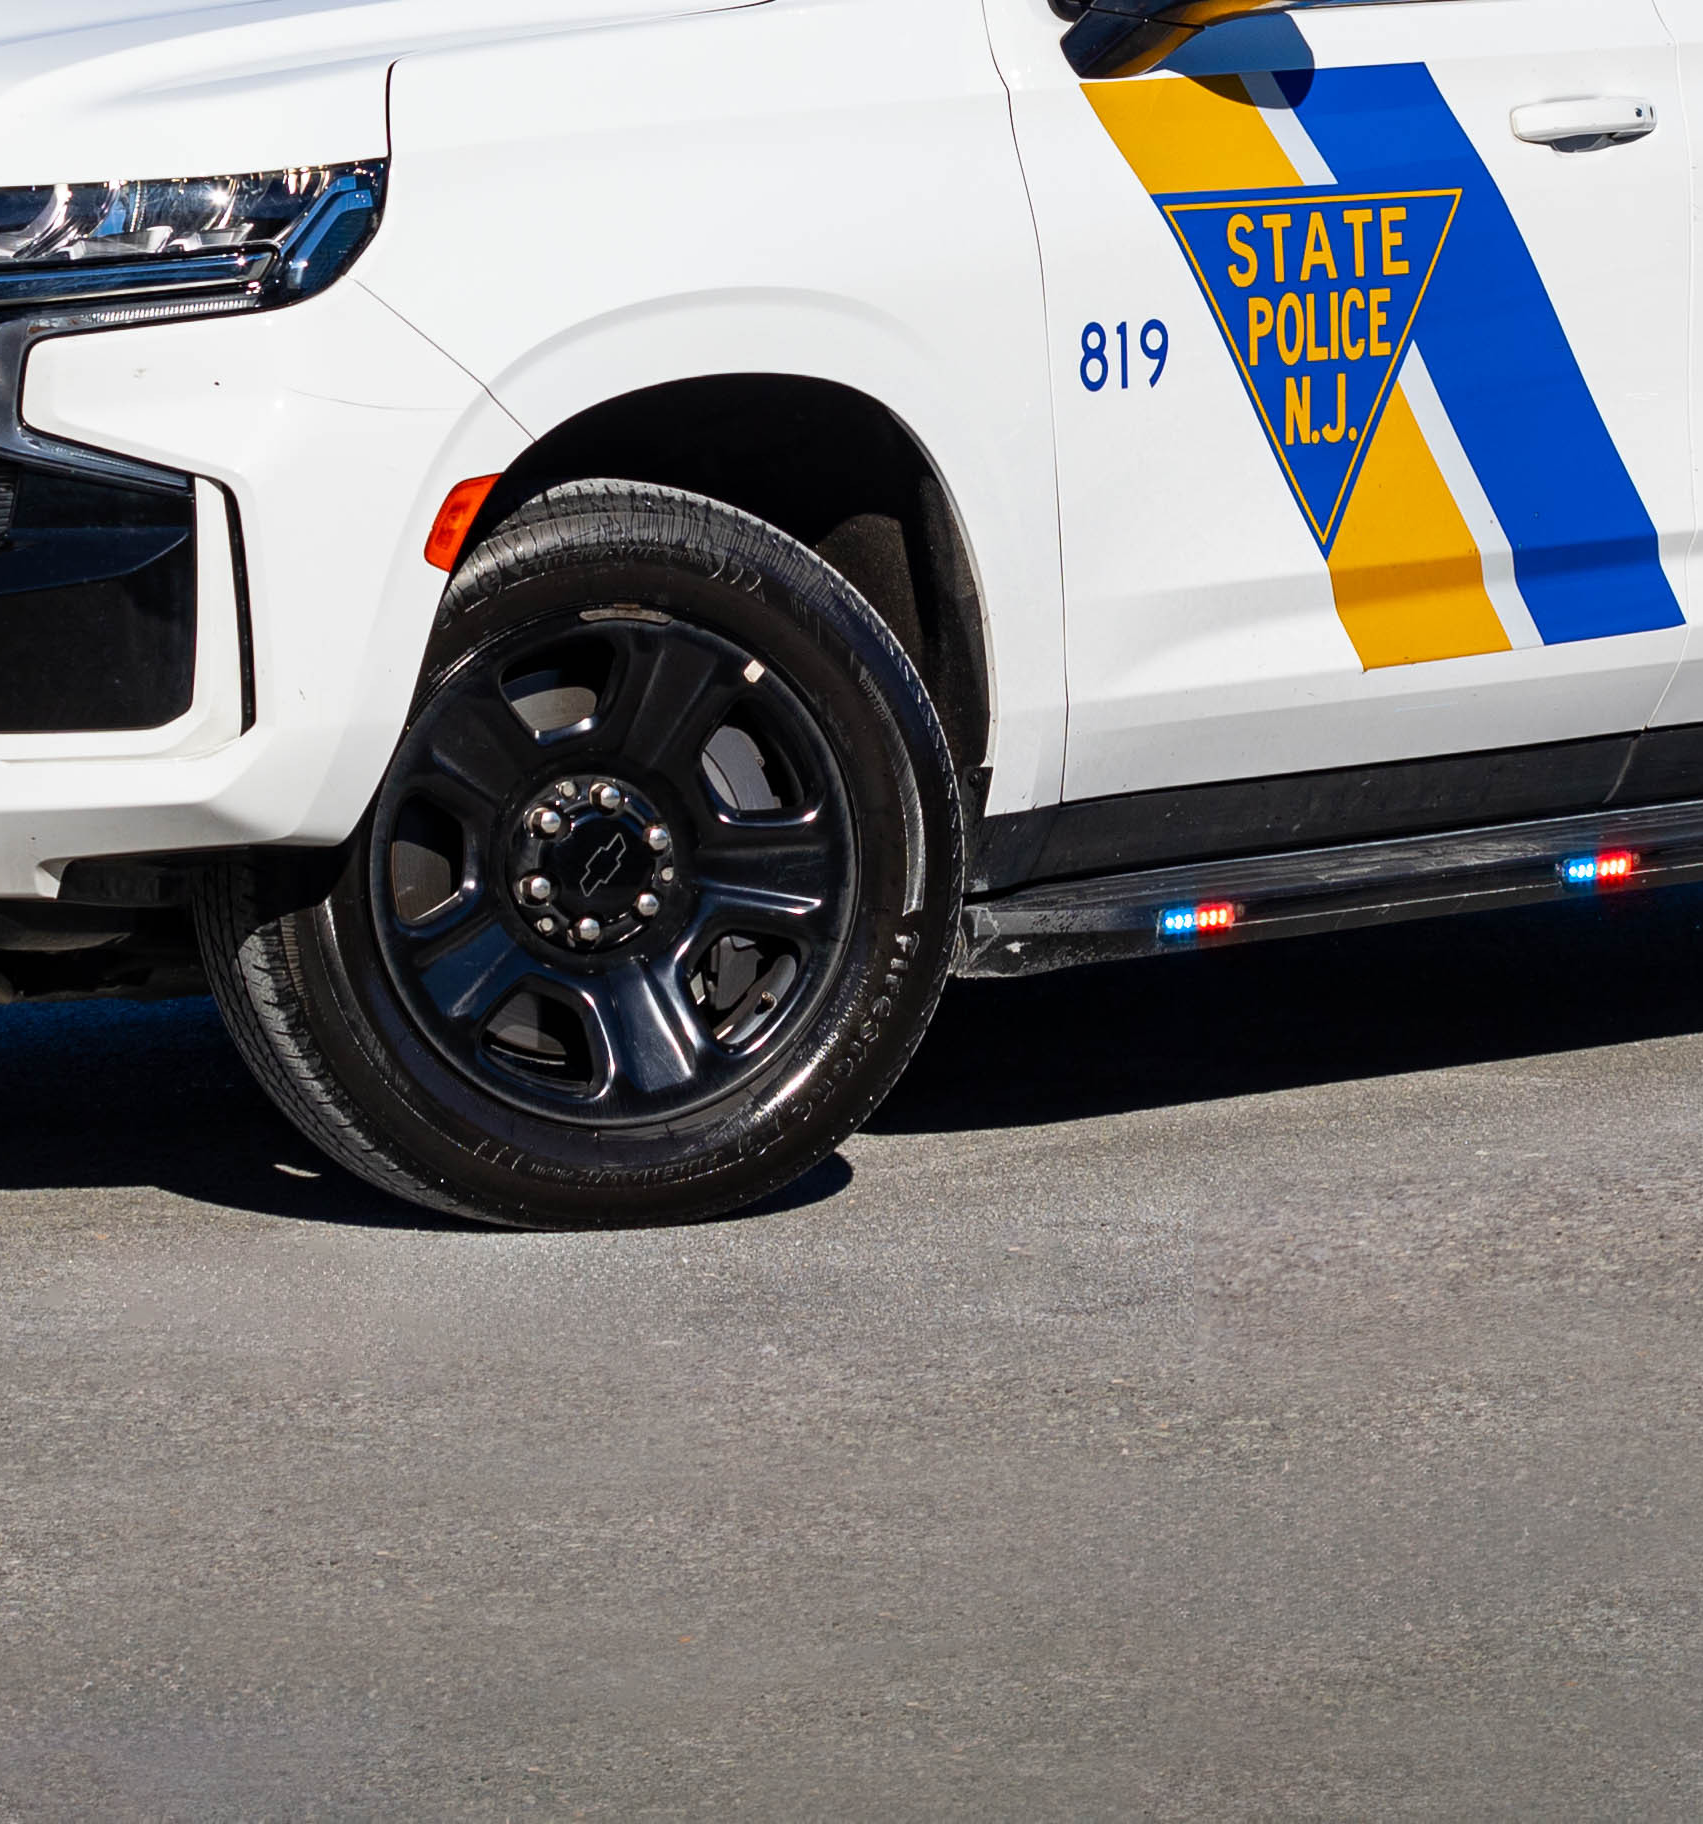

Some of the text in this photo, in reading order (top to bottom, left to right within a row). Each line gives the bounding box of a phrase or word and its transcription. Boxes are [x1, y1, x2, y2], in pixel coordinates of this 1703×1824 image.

[1226, 205, 1410, 288] STATE
[1079, 319, 1169, 392] 819
[1248, 287, 1393, 368] POLICE
[1284, 374, 1358, 446] N.J.
